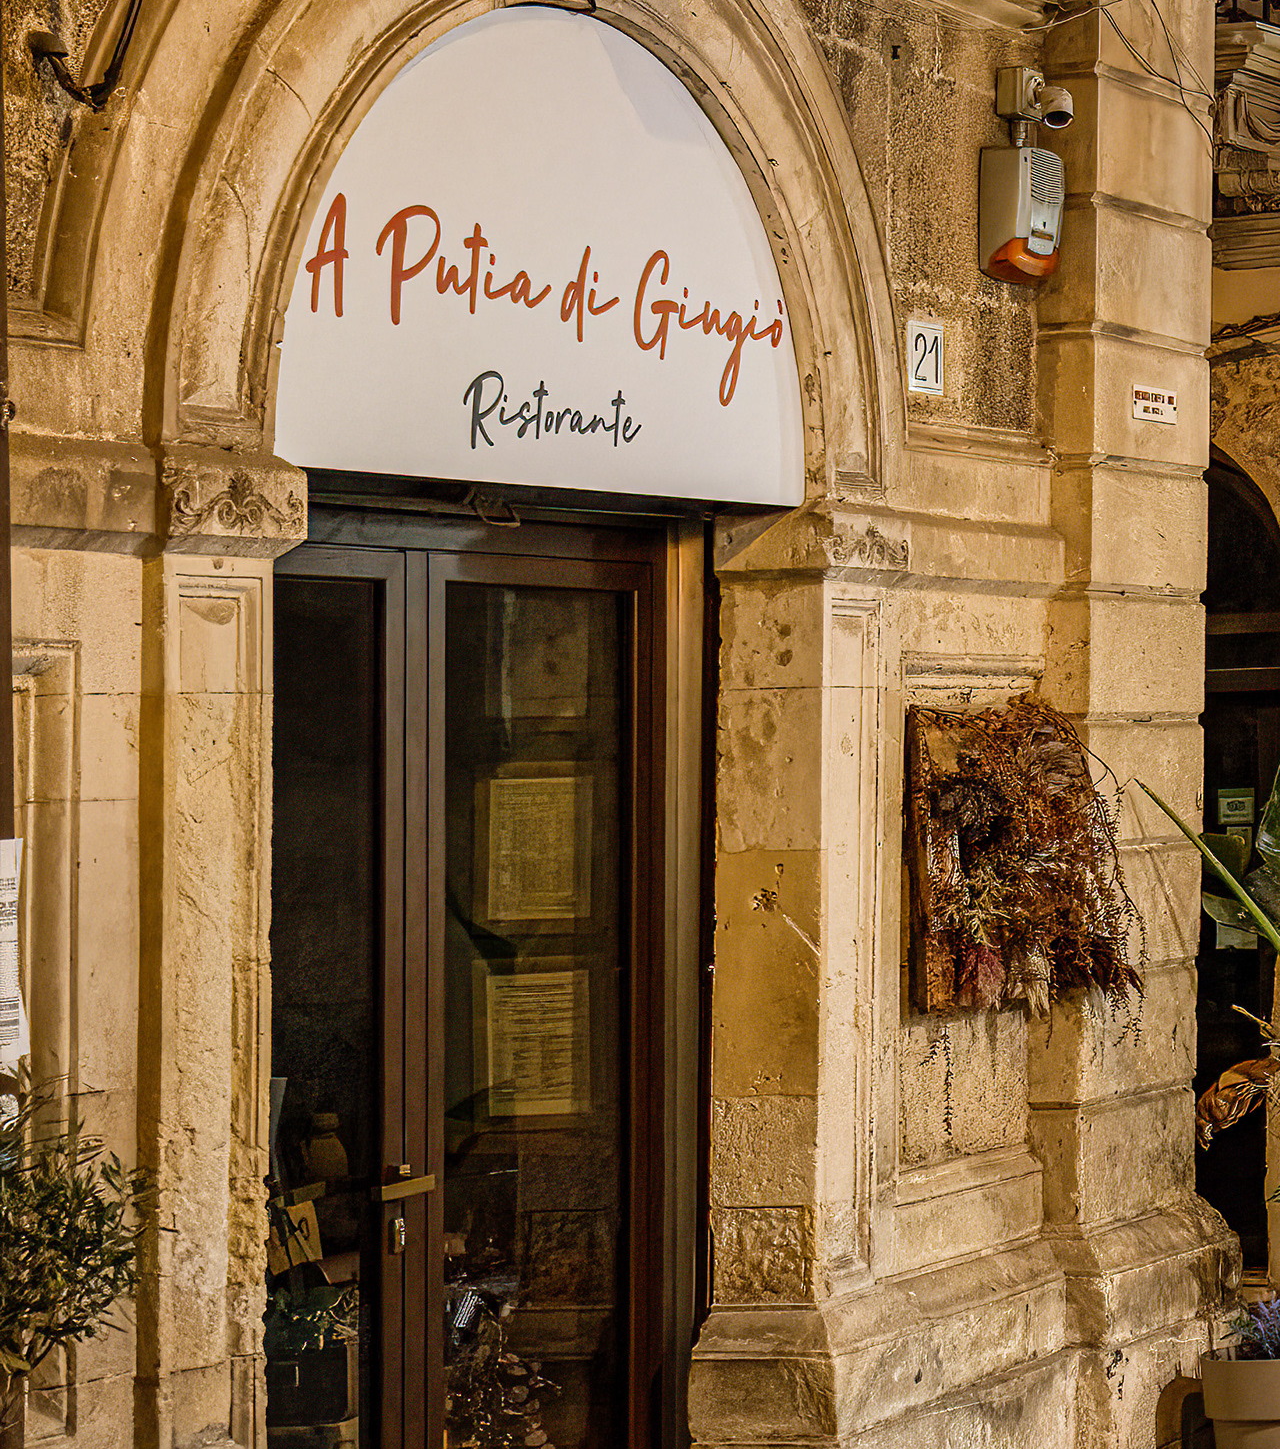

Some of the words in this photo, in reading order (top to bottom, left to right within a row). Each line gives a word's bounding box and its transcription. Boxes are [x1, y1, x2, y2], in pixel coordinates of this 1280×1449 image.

[305, 193, 349, 317] A
[375, 204, 552, 326] Putia
[560, 245, 619, 342] di
[915, 332, 938, 383] 21
[464, 370, 642, 451] Ristorante
